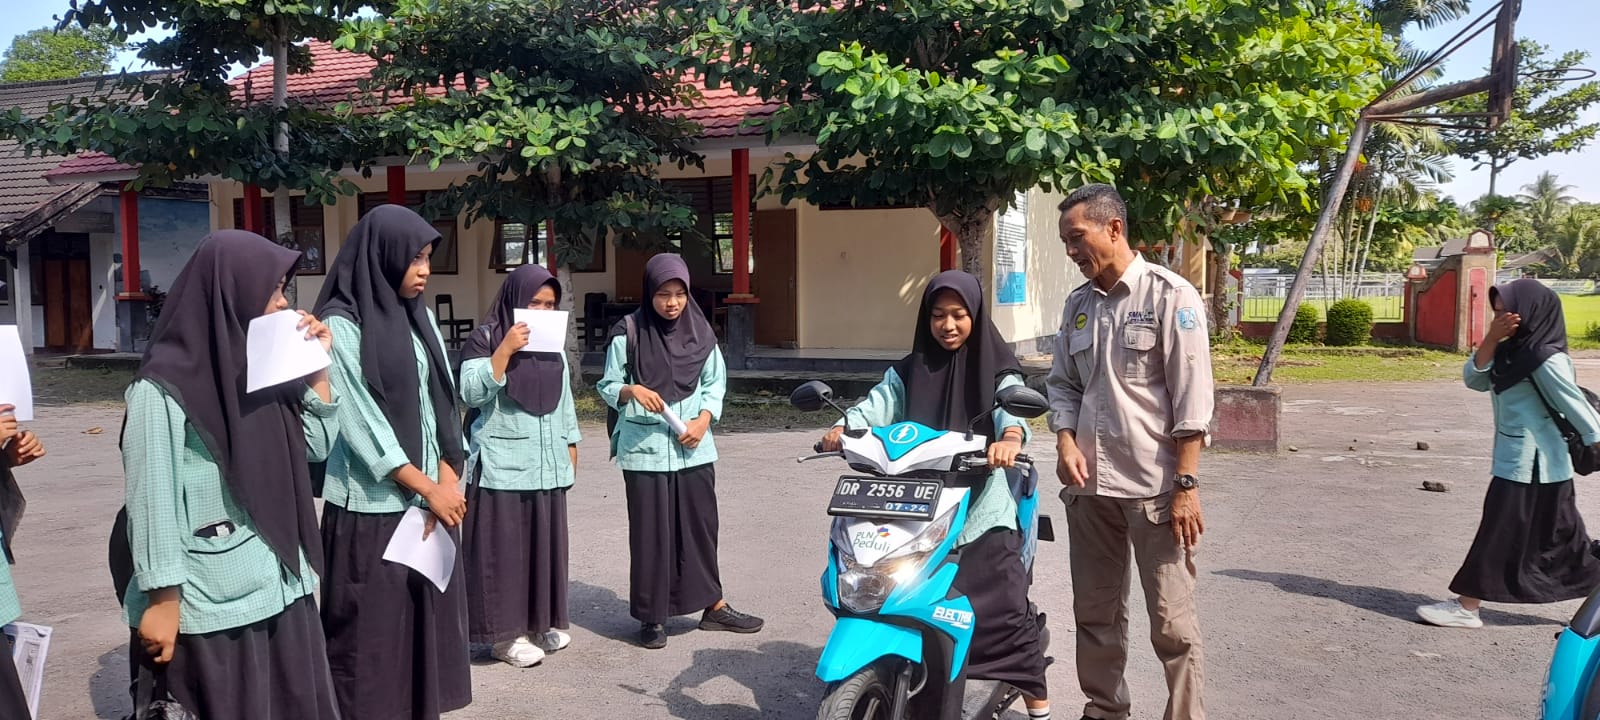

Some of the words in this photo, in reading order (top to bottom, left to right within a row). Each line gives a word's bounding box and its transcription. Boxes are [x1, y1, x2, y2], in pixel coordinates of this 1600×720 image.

[840, 482, 860, 496] DR
[866, 483, 906, 498] 2556
[914, 486, 935, 500] UE
[853, 535, 891, 553] Peduli
[856, 531, 874, 539] PLN
